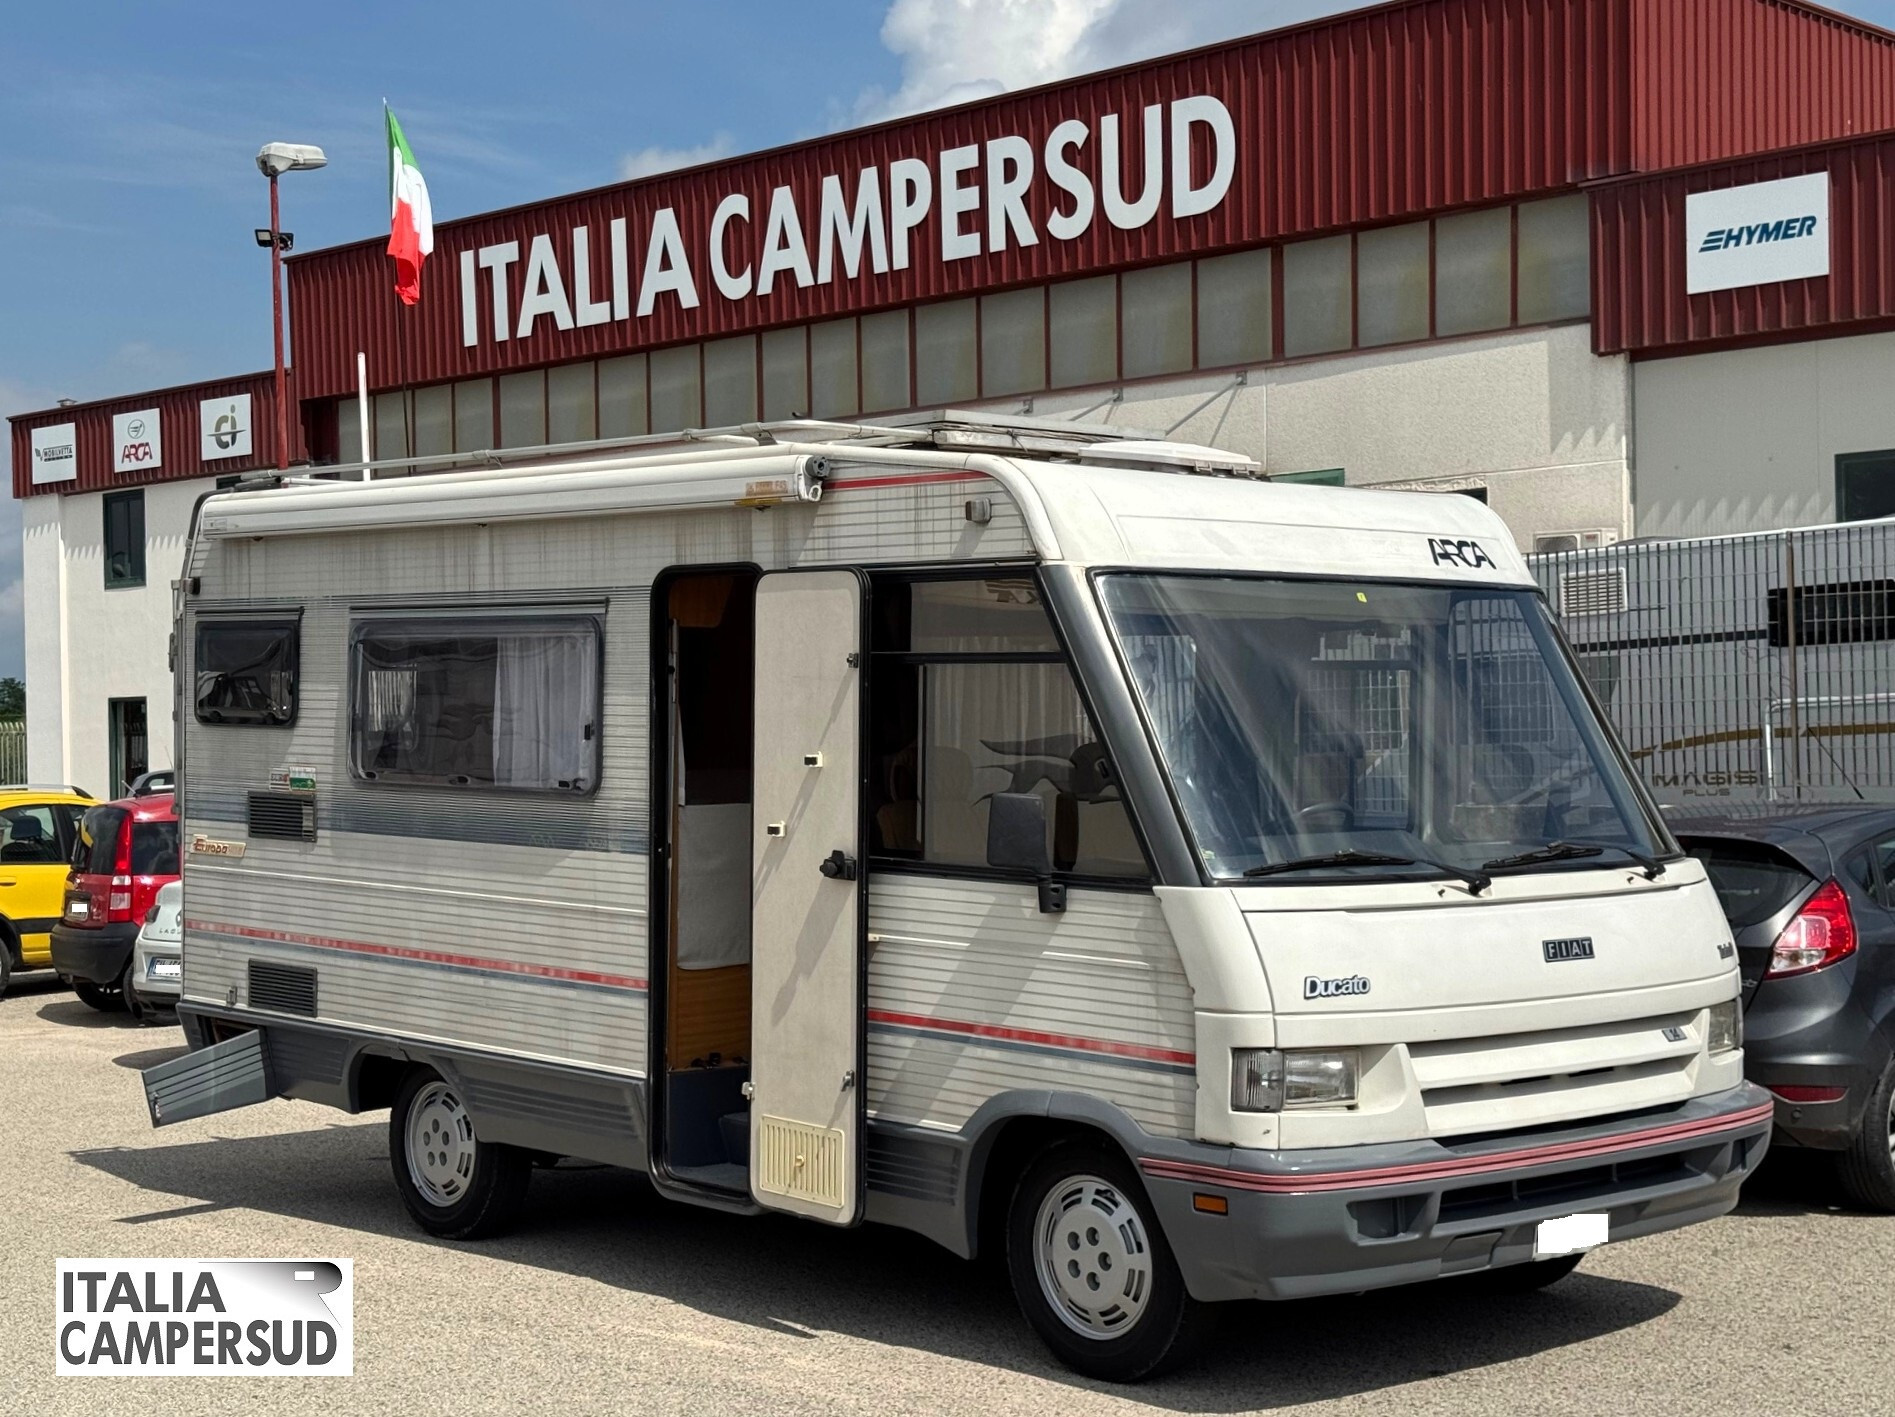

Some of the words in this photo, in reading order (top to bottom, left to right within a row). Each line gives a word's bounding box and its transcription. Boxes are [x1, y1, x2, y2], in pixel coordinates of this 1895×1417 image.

[461, 207, 700, 346] ITALIA
[709, 95, 1236, 301] CAMPERSUD
[1722, 215, 1817, 249] HYMER
[121, 442, 153, 464] ARCA
[1427, 538, 1497, 570] ARCA
[1683, 788, 1730, 797] PLUS
[1546, 938, 1594, 960] FIAT
[1304, 974, 1371, 1000] Ducato
